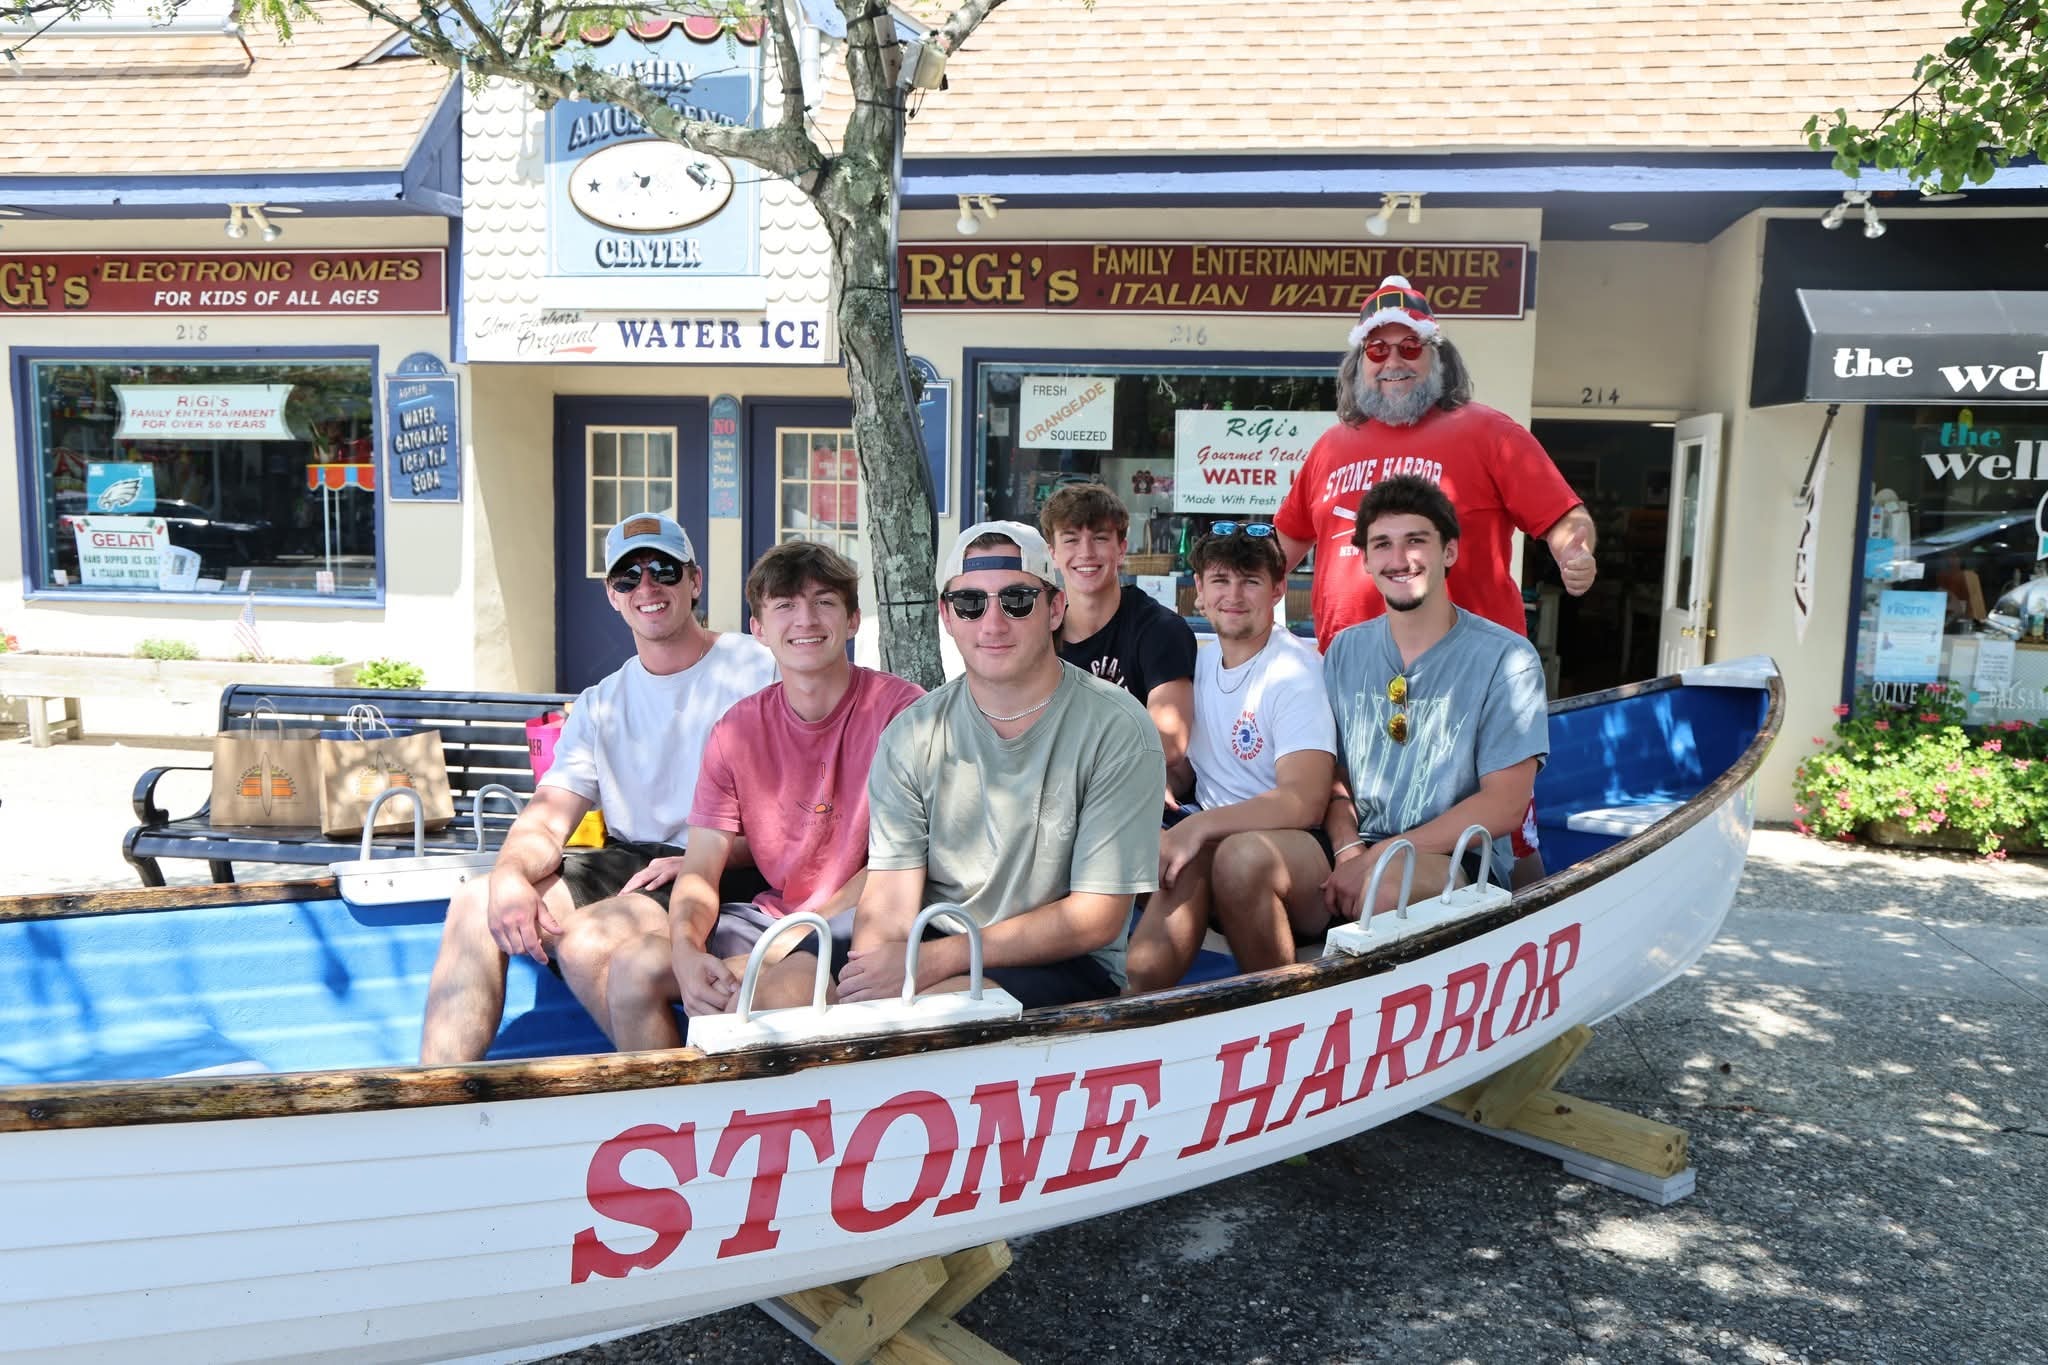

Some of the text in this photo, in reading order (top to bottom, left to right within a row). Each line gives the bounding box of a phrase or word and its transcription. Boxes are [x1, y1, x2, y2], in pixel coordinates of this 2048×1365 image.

[596, 239, 702, 268] CENTER
[1093, 244, 1500, 278] FAMILY ENTERTAINMENT CENTER
[101, 259, 421, 283] ELECTRONIC GAMES
[906, 253, 1080, 304] RiGi's
[154, 290, 380, 306] FOR KIDS OF ALL AGES
[1110, 282, 1249, 306] ITALIAN
[1270, 283, 1376, 307] WATE
[176, 324, 208, 341] 218
[617, 319, 820, 349] WATER ICE
[1833, 347, 1914, 379] the
[1033, 384, 1067, 397] FRESH
[1581, 387, 1620, 406] 214
[130, 409, 276, 418] FAMILY ENTERTAINMENT
[401, 405, 437, 429] WATER
[1025, 381, 1107, 442] ORANGEADE
[142, 420, 267, 429] FOR OVER 50 YEARS
[713, 418, 736, 435] NO
[1050, 430, 1107, 442] SQUEEZED
[1226, 417, 1300, 443] RiGi's
[1940, 422, 2002, 448] the
[394, 424, 449, 453] GATORADE
[401, 447, 447, 474] ICED TEA
[1197, 445, 1307, 465] Gourmet Itali
[412, 471, 441, 494] SODA
[1203, 468, 1278, 486] WATER
[1322, 458, 1378, 503] STONE
[1222, 495, 1246, 505] With
[1249, 495, 1277, 505] Fresh
[92, 533, 155, 548] GELATI
[1872, 682, 1919, 705] OLIVE
[570, 922, 1582, 1284] STONE HARBOR
